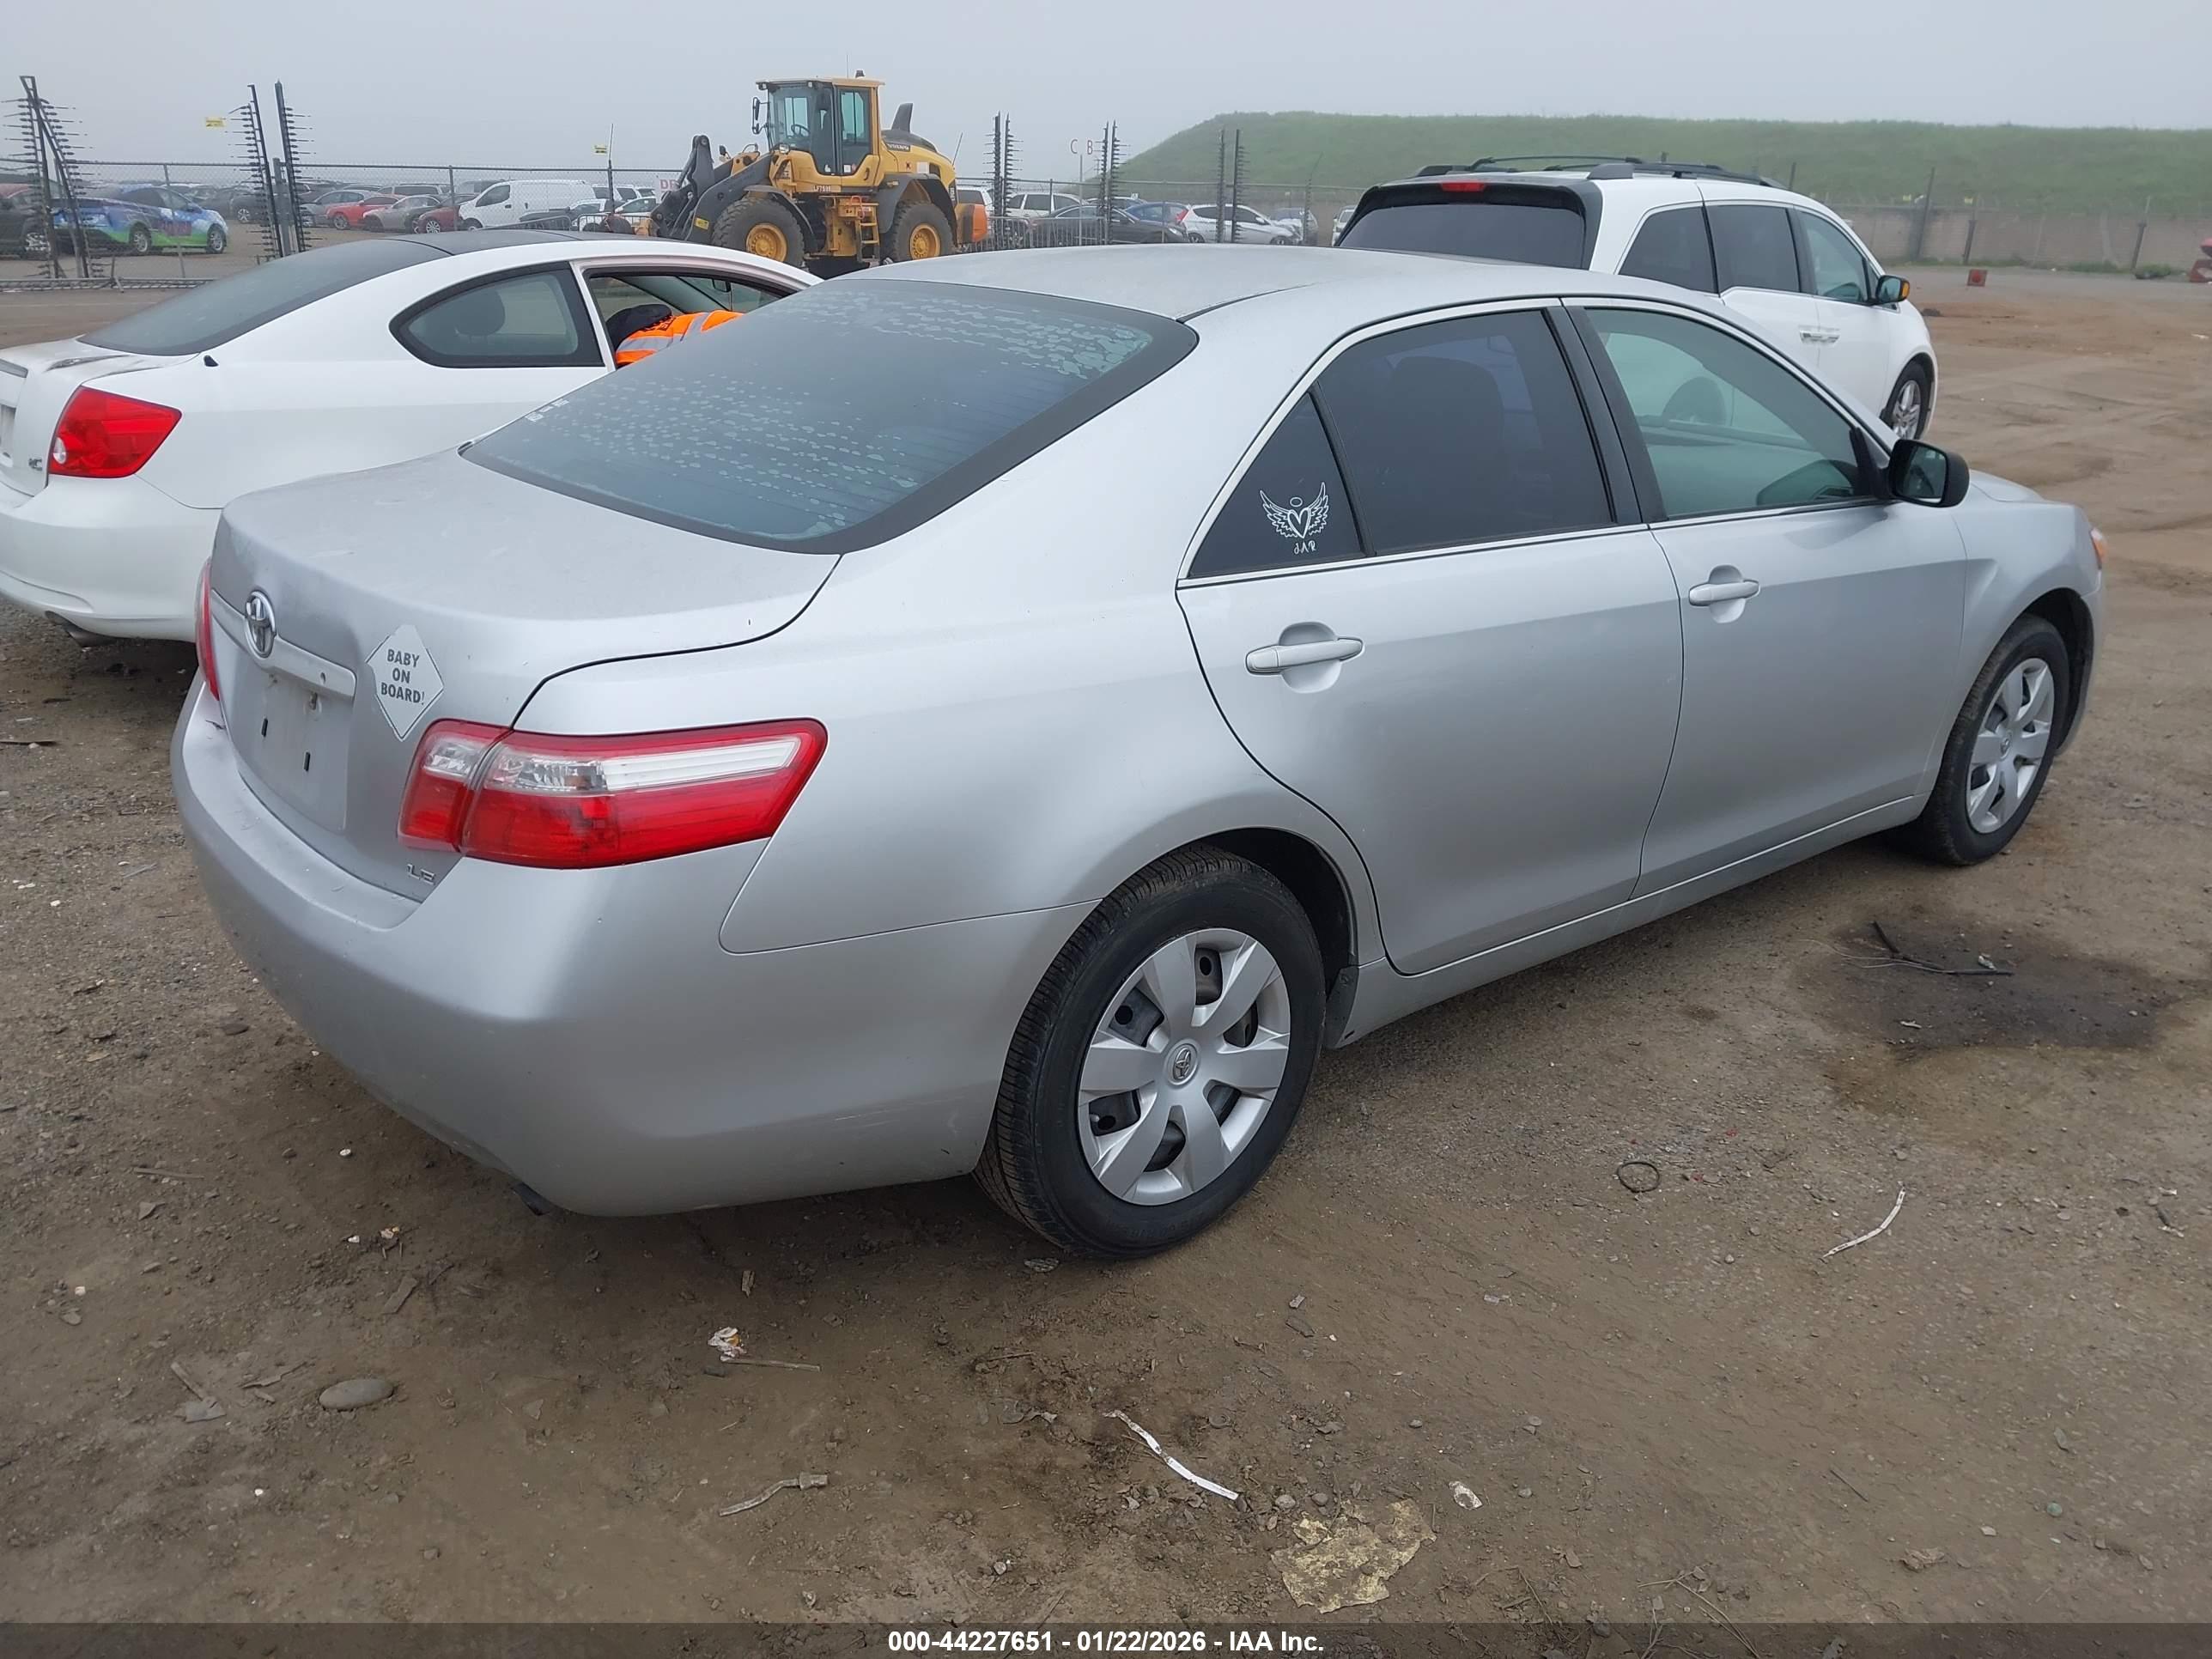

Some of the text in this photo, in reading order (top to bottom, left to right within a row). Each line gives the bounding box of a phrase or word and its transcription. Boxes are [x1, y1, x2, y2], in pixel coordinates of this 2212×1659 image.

[386, 648, 420, 668] BABY
[392, 667, 410, 684] ON
[381, 682, 425, 705] BOARD!
[407, 863, 435, 885] LE
